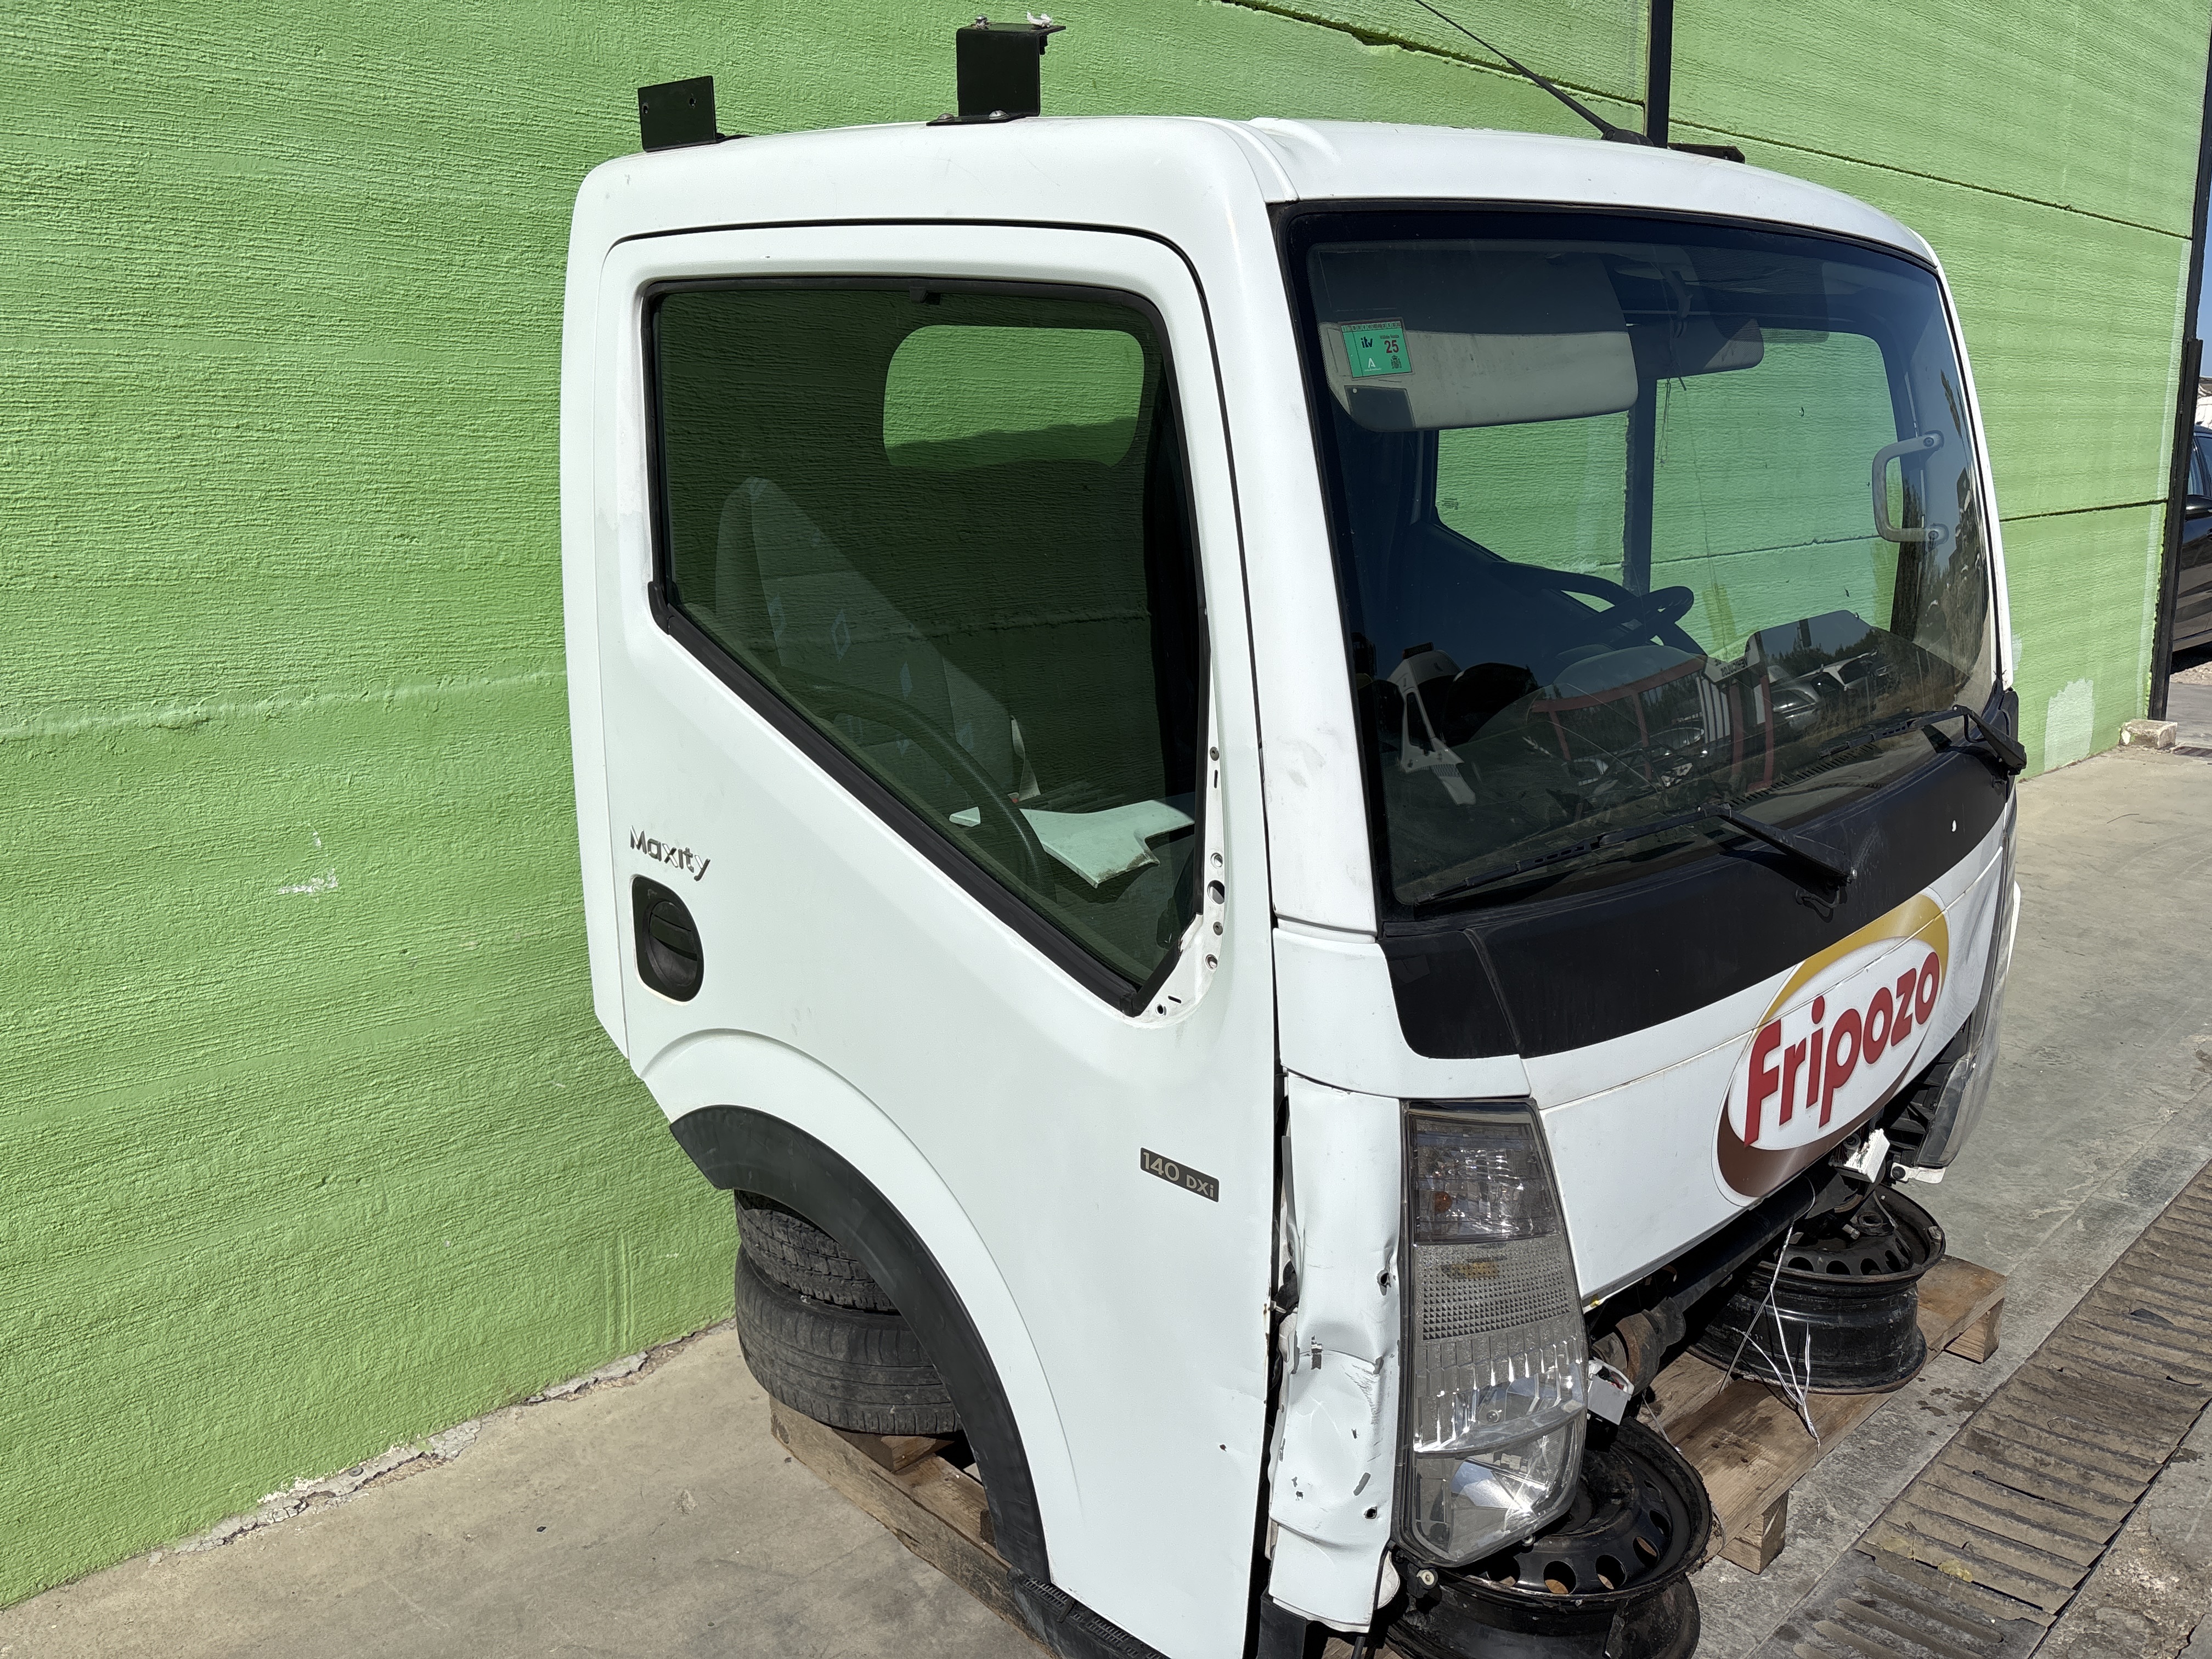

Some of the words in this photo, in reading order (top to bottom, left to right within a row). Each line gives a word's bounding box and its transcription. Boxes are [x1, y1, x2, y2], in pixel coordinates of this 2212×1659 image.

[1361, 336, 1373, 348] itv
[1384, 340, 1399, 353] 25
[629, 825, 711, 882] Maxity
[1743, 951, 1940, 1148] Fripozo
[1143, 1152, 1180, 1182] 140
[1186, 1174, 1215, 1198] DXi
